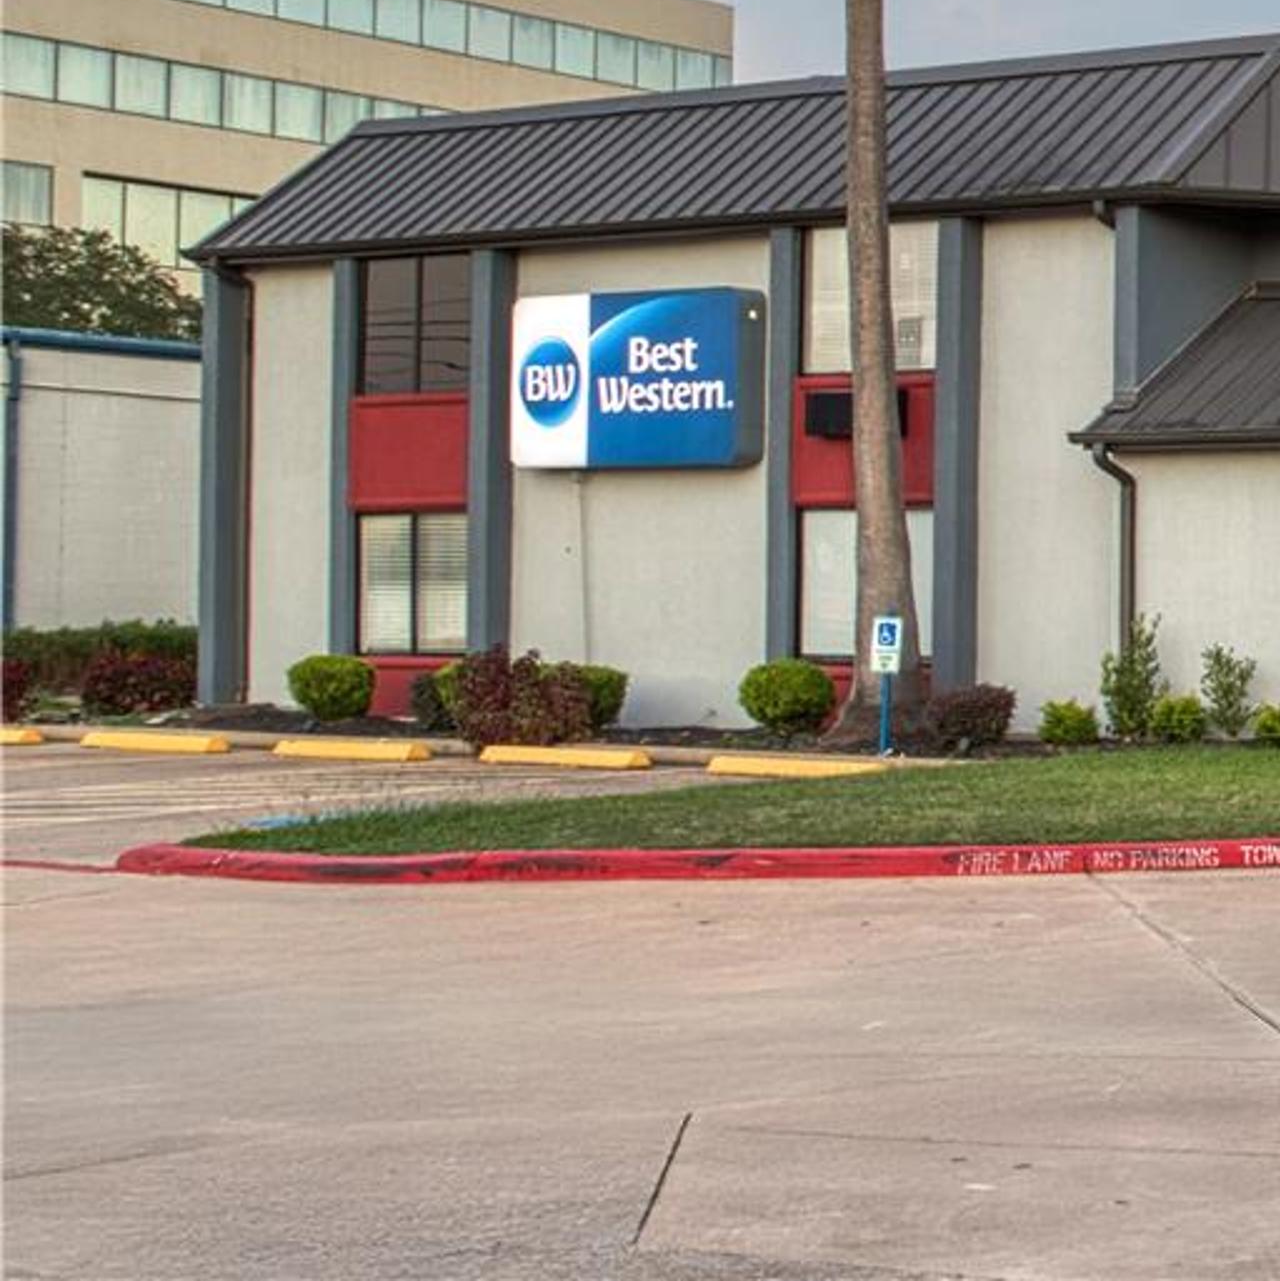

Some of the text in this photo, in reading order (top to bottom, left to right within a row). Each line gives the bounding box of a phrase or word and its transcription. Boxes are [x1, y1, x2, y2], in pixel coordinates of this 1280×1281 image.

[628, 336, 698, 373] Best
[525, 364, 576, 402] BW
[1093, 850, 1123, 869] NO
[1129, 847, 1220, 869] PARKING
